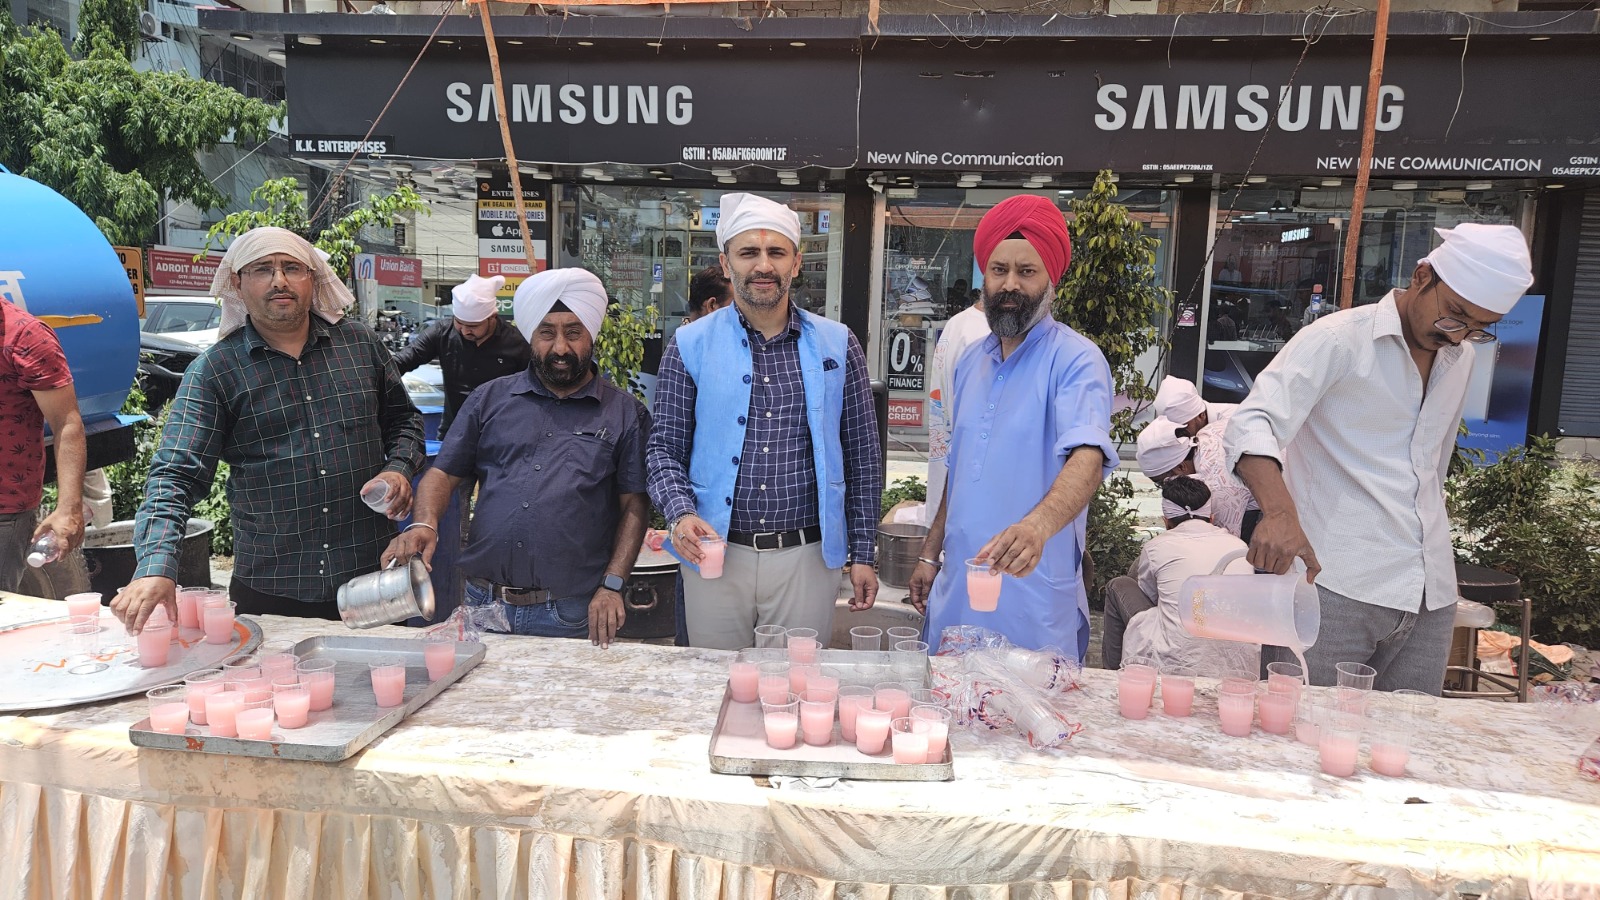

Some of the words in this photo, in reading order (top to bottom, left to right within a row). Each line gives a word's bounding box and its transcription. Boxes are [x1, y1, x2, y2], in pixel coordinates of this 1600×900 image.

[446, 82, 693, 126] SAMSUNG
[1094, 83, 1405, 132] SAMSUNG
[295, 139, 316, 152] K.K.
[318, 140, 387, 154] ENTERPRISES
[867, 150, 902, 164] New
[905, 150, 938, 165] Nine
[941, 152, 1064, 167] Communication
[1316, 156, 1353, 170] NEW
[1399, 157, 1542, 172] COMMUNICATION
[1569, 156, 1598, 165] GSTIN
[481, 210, 503, 219] MOBILE
[1281, 227, 1310, 243] SAMSUNG
[155, 262, 190, 274] ADROIT
[191, 264, 219, 277] MARK
[380, 259, 399, 271] Union
[399, 260, 415, 272] Bank
[889, 377, 922, 388] FINANCE
[888, 405, 917, 413] HOME
